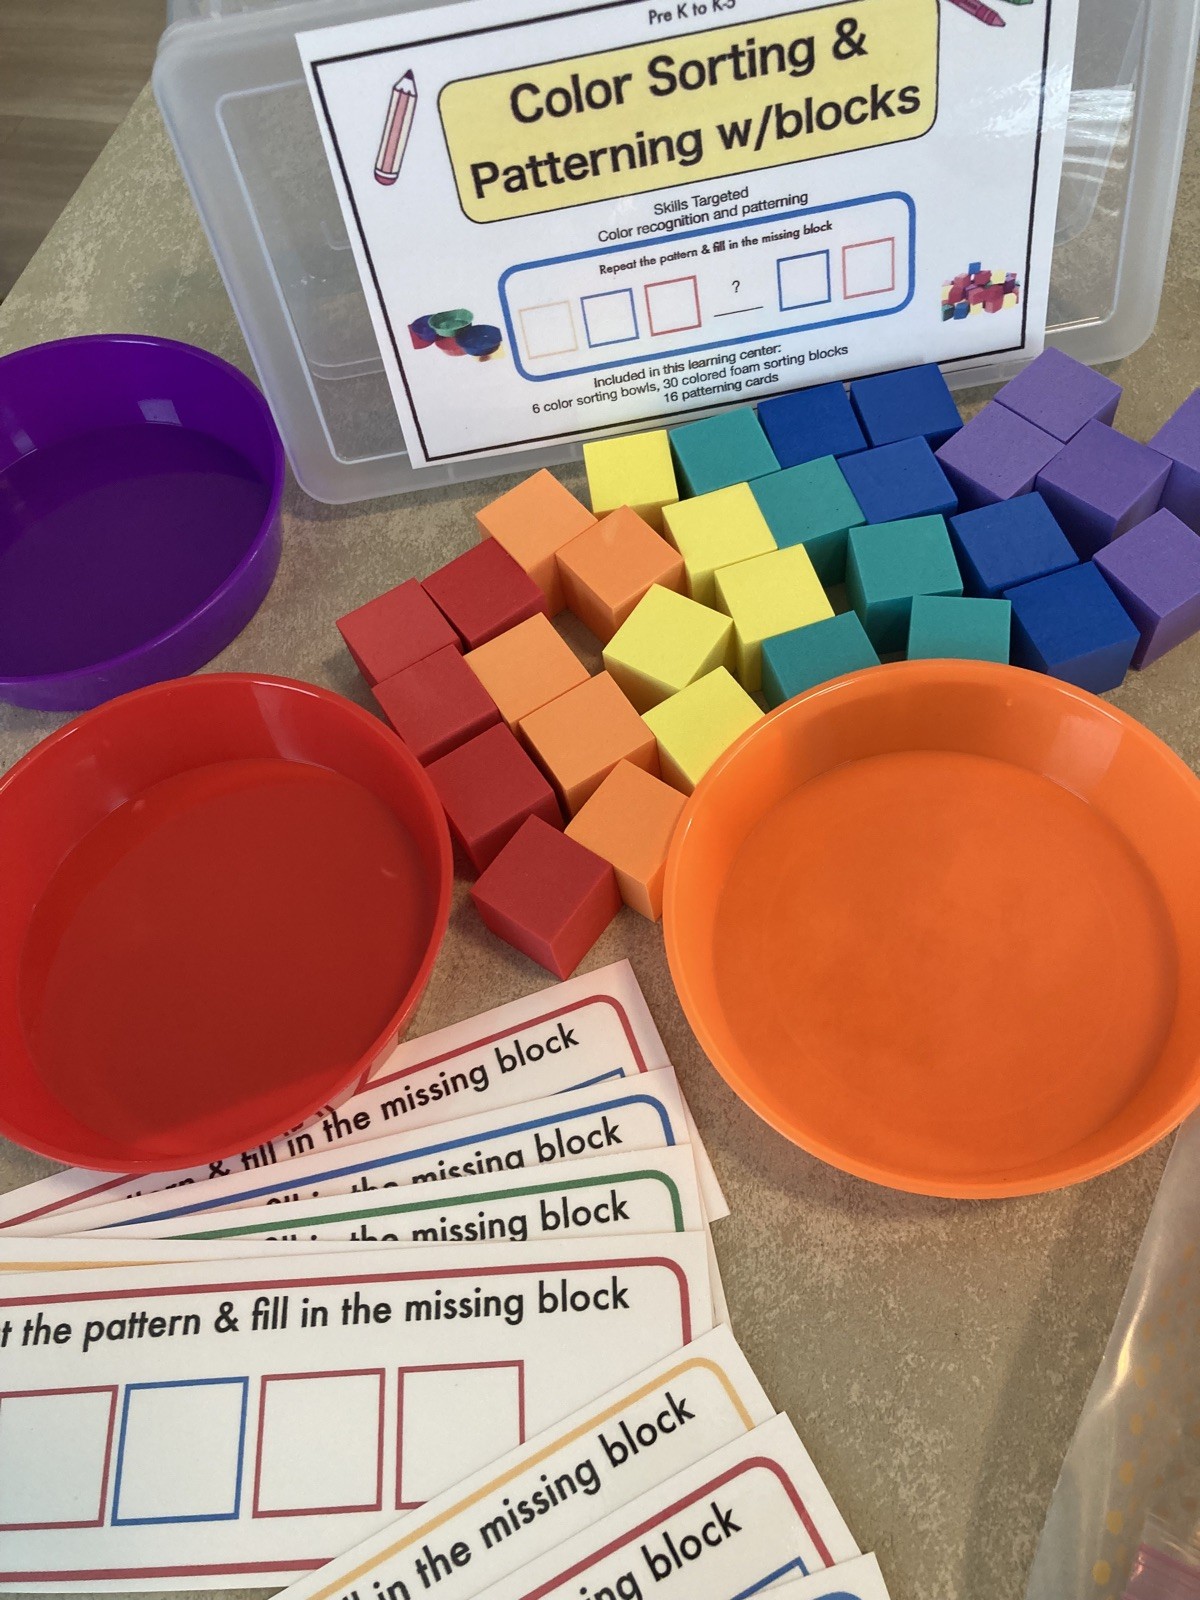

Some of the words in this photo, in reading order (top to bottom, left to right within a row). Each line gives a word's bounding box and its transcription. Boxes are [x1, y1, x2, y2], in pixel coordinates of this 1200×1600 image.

[649, 9, 672, 25] Pre
[677, 3, 688, 19] K
[693, 4, 707, 16] to
[510, 71, 633, 123] Color
[648, 36, 816, 97] Sorting
[832, 17, 868, 60] &
[470, 129, 703, 199] Patterning
[717, 83, 921, 151] w/blocks
[598, 227, 633, 242] Color
[637, 212, 709, 236] recognition
[713, 205, 738, 220] and
[742, 193, 808, 220] patterning
[654, 199, 688, 216] Skills
[692, 187, 749, 209] Targeted
[599, 259, 637, 275] Repeat
[640, 256, 657, 267] the
[659, 250, 698, 266] pattern
[701, 245, 710, 255] &
[713, 241, 726, 252] fill
[729, 239, 738, 250] in
[742, 236, 759, 247] the
[761, 228, 800, 244] missing
[803, 221, 833, 235] block
[731, 280, 741, 293] ?
[532, 403, 540, 414] 6
[544, 396, 573, 413] color
[576, 389, 618, 406] sorting
[621, 380, 660, 398] bowls,
[663, 378, 679, 389] 30
[681, 367, 727, 387] colored
[730, 363, 761, 378] foam
[764, 354, 805, 372] sorting
[808, 344, 849, 362] blocks
[594, 369, 646, 388] Included
[649, 367, 660, 377] in
[663, 361, 686, 375] this
[688, 354, 736, 372] learning
[739, 344, 782, 361] center:
[663, 391, 679, 403] 16
[681, 381, 743, 403] patterning
[745, 372, 779, 388] cards
[322, 1107, 371, 1142] the
[380, 1063, 490, 1121] missing
[494, 1023, 579, 1074] block
[534, 1116, 623, 1163] block
[412, 1211, 527, 1242] missing
[539, 1189, 630, 1231] block
[22, 1312, 72, 1346] the
[82, 1311, 201, 1352] pattern
[214, 1301, 240, 1333] &
[251, 1296, 289, 1331] fill
[301, 1298, 330, 1329] in
[341, 1292, 393, 1325] the
[404, 1287, 525, 1326] missing
[537, 1276, 630, 1314] block
[415, 1541, 472, 1589] the
[478, 1460, 602, 1551] missing
[597, 1392, 696, 1469] block
[646, 1502, 742, 1581] block
